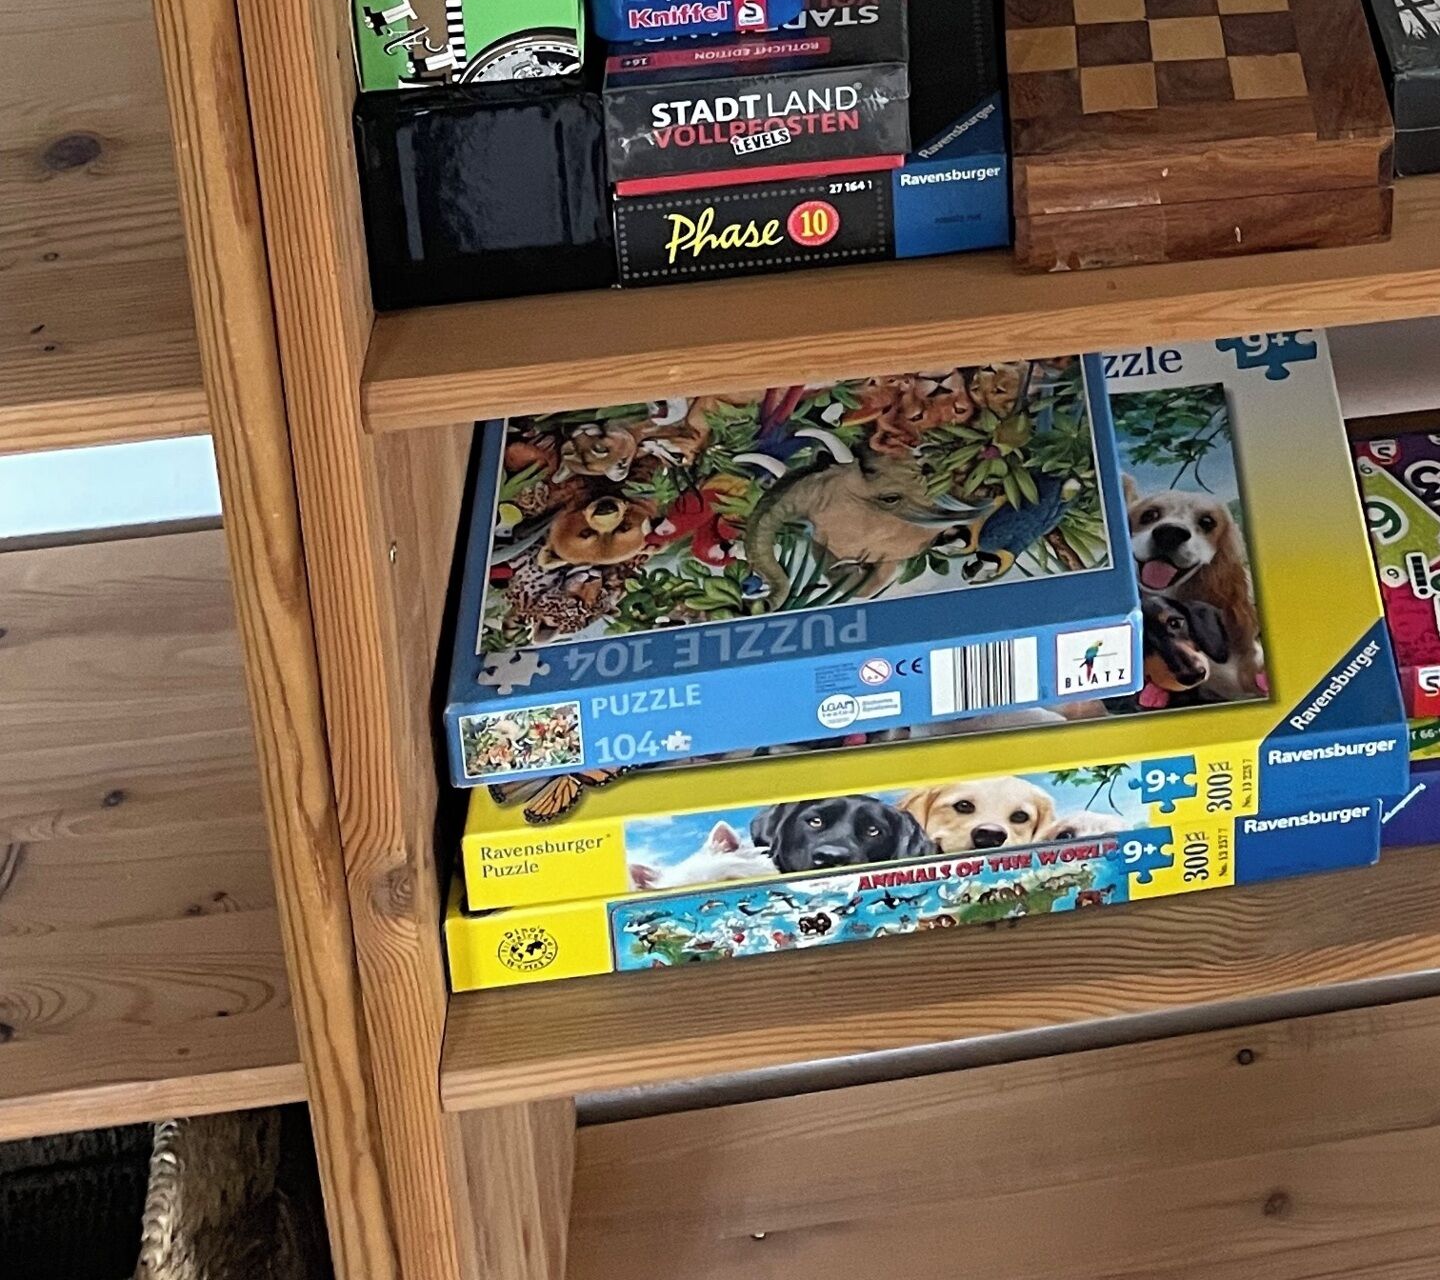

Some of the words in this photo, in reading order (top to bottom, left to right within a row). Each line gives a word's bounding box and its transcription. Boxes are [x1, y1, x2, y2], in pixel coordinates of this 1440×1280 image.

[628, 1, 730, 30] Kniffel
[693, 46, 752, 60] EDITION
[755, 41, 820, 56] ROTLICHT
[651, 93, 762, 128] STADT
[767, 85, 859, 116] LAND
[655, 109, 860, 149] VOLLPFOSTEN
[734, 129, 790, 154] LEVELS
[918, 103, 997, 159] Ravensburger
[828, 182, 844, 194] 27
[845, 181, 865, 194] 164
[900, 166, 1001, 187] Ravensburger
[663, 206, 784, 264] Phase
[800, 209, 829, 238] 10
[670, 608, 869, 671] PUZZLE
[562, 639, 655, 681] 104
[1064, 669, 1127, 690] BLATZ
[1289, 640, 1383, 731] Ravensburger
[590, 683, 702, 720] PUZZLE
[594, 731, 661, 765] 104
[1266, 737, 1397, 767] Ravensburger
[1145, 768, 1181, 792] 9+
[1208, 761, 1233, 772] XXL
[1205, 771, 1233, 812] 300
[1242, 801, 1371, 836] Ravensburger
[480, 836, 605, 863] Ravensburger
[1184, 831, 1210, 841] XXL
[1123, 840, 1157, 864] 9+
[1182, 840, 1210, 882] 300
[481, 859, 540, 880] Puzzle
[858, 864, 951, 892] ANIMALS
[955, 859, 984, 879] OF
[988, 851, 1031, 872] THE
